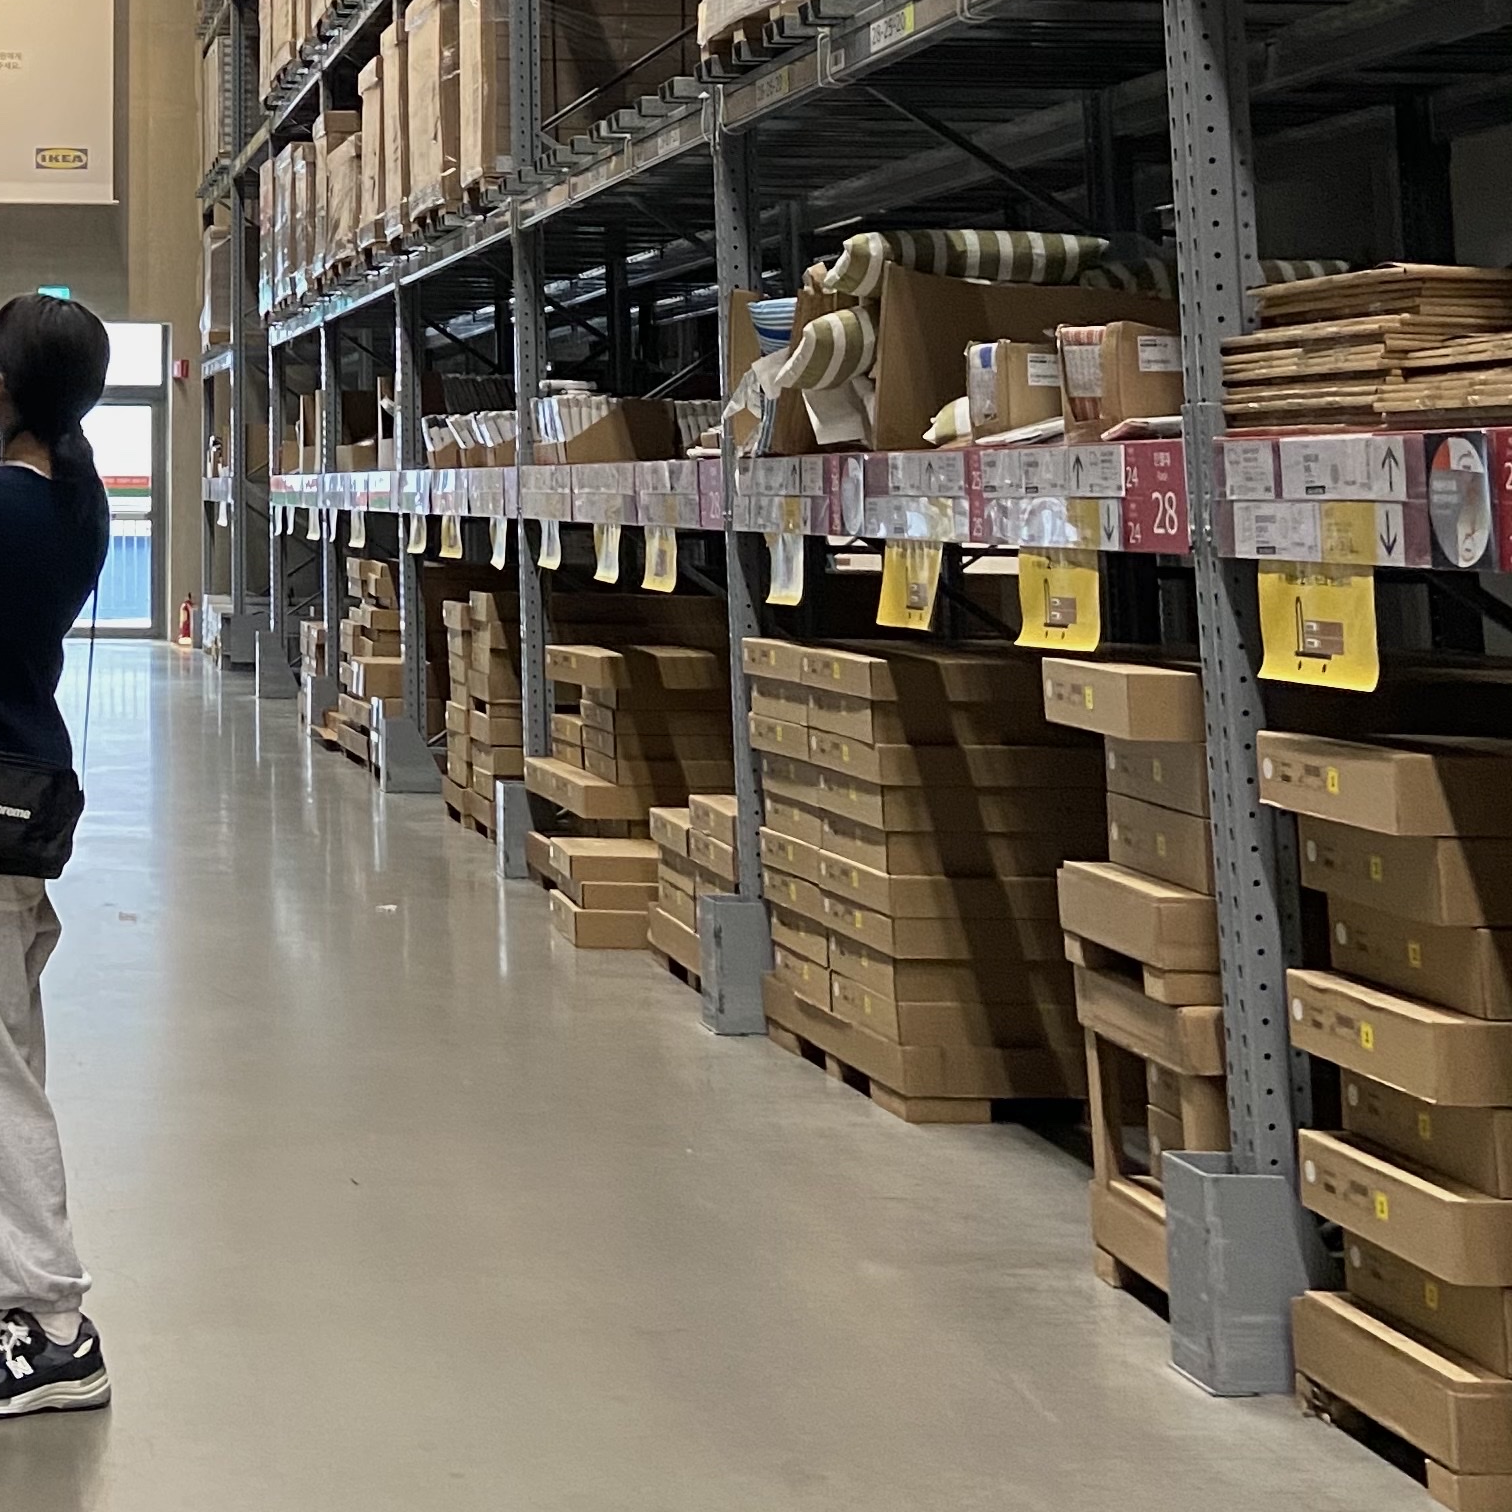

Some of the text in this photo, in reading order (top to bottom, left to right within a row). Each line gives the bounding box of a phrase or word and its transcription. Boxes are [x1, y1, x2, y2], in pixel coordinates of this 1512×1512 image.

[1126, 466, 1138, 488] 24
[1151, 491, 1179, 535] 28
[1127, 521, 1142, 544] 24
[5, 1355, 34, 1380] N
